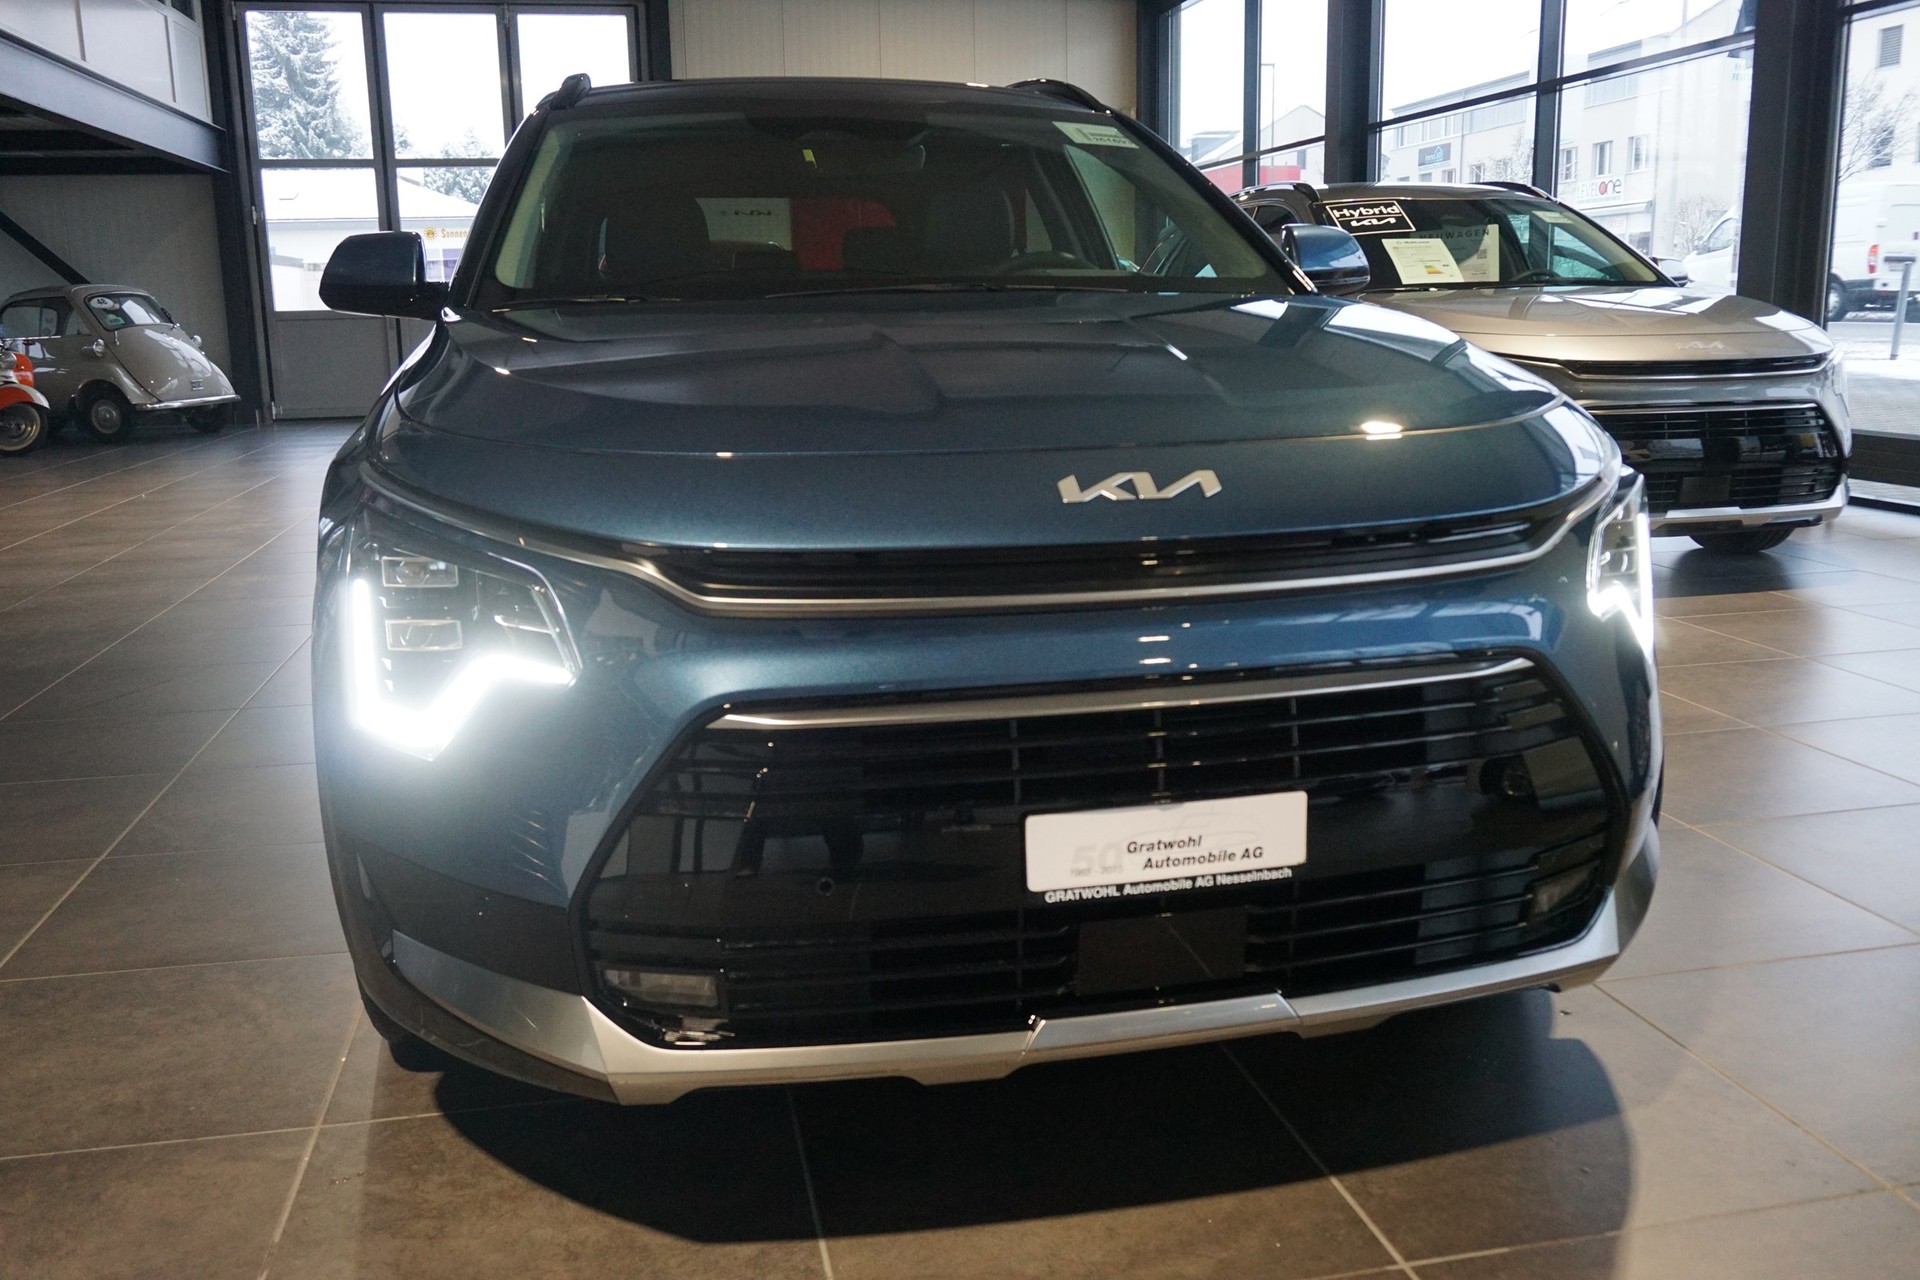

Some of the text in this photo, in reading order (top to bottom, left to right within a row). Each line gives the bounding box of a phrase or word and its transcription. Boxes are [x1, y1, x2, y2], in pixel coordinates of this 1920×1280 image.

[1332, 204, 1401, 219] Hybrid
[1057, 469, 1223, 504] KIA
[1127, 835, 1203, 854] Gratwohl
[1143, 846, 1265, 871] Automobile AG
[1044, 883, 1121, 904] GRATWOHL
[1123, 873, 1193, 896] Automobile
[1195, 874, 1215, 888] AG
